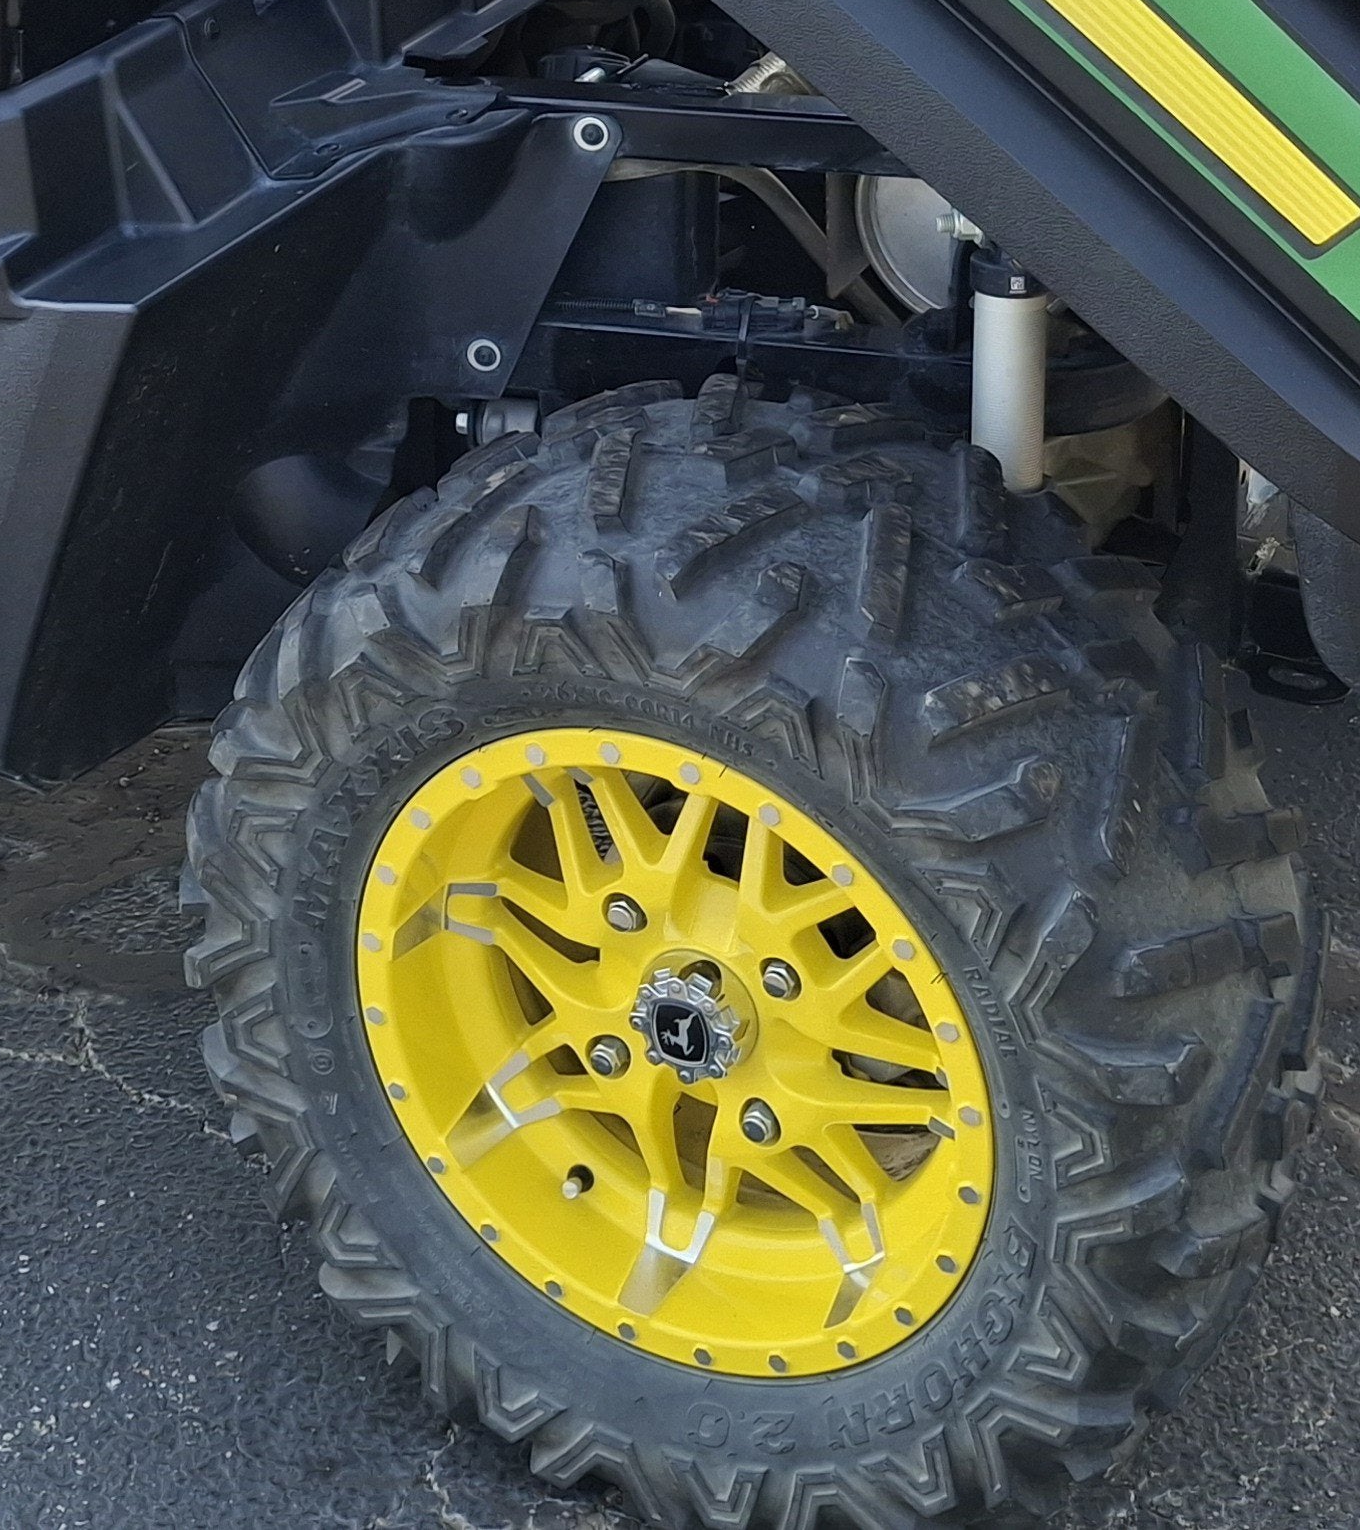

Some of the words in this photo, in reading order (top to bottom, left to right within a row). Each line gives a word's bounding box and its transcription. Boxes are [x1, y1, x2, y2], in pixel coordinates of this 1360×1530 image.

[708, 722, 754, 757] NHS
[290, 705, 467, 933] MAXXIS
[963, 965, 1019, 1060] RADIAL
[827, 1213, 1038, 1449] BIGHORN
[685, 1400, 797, 1456] 2.0
